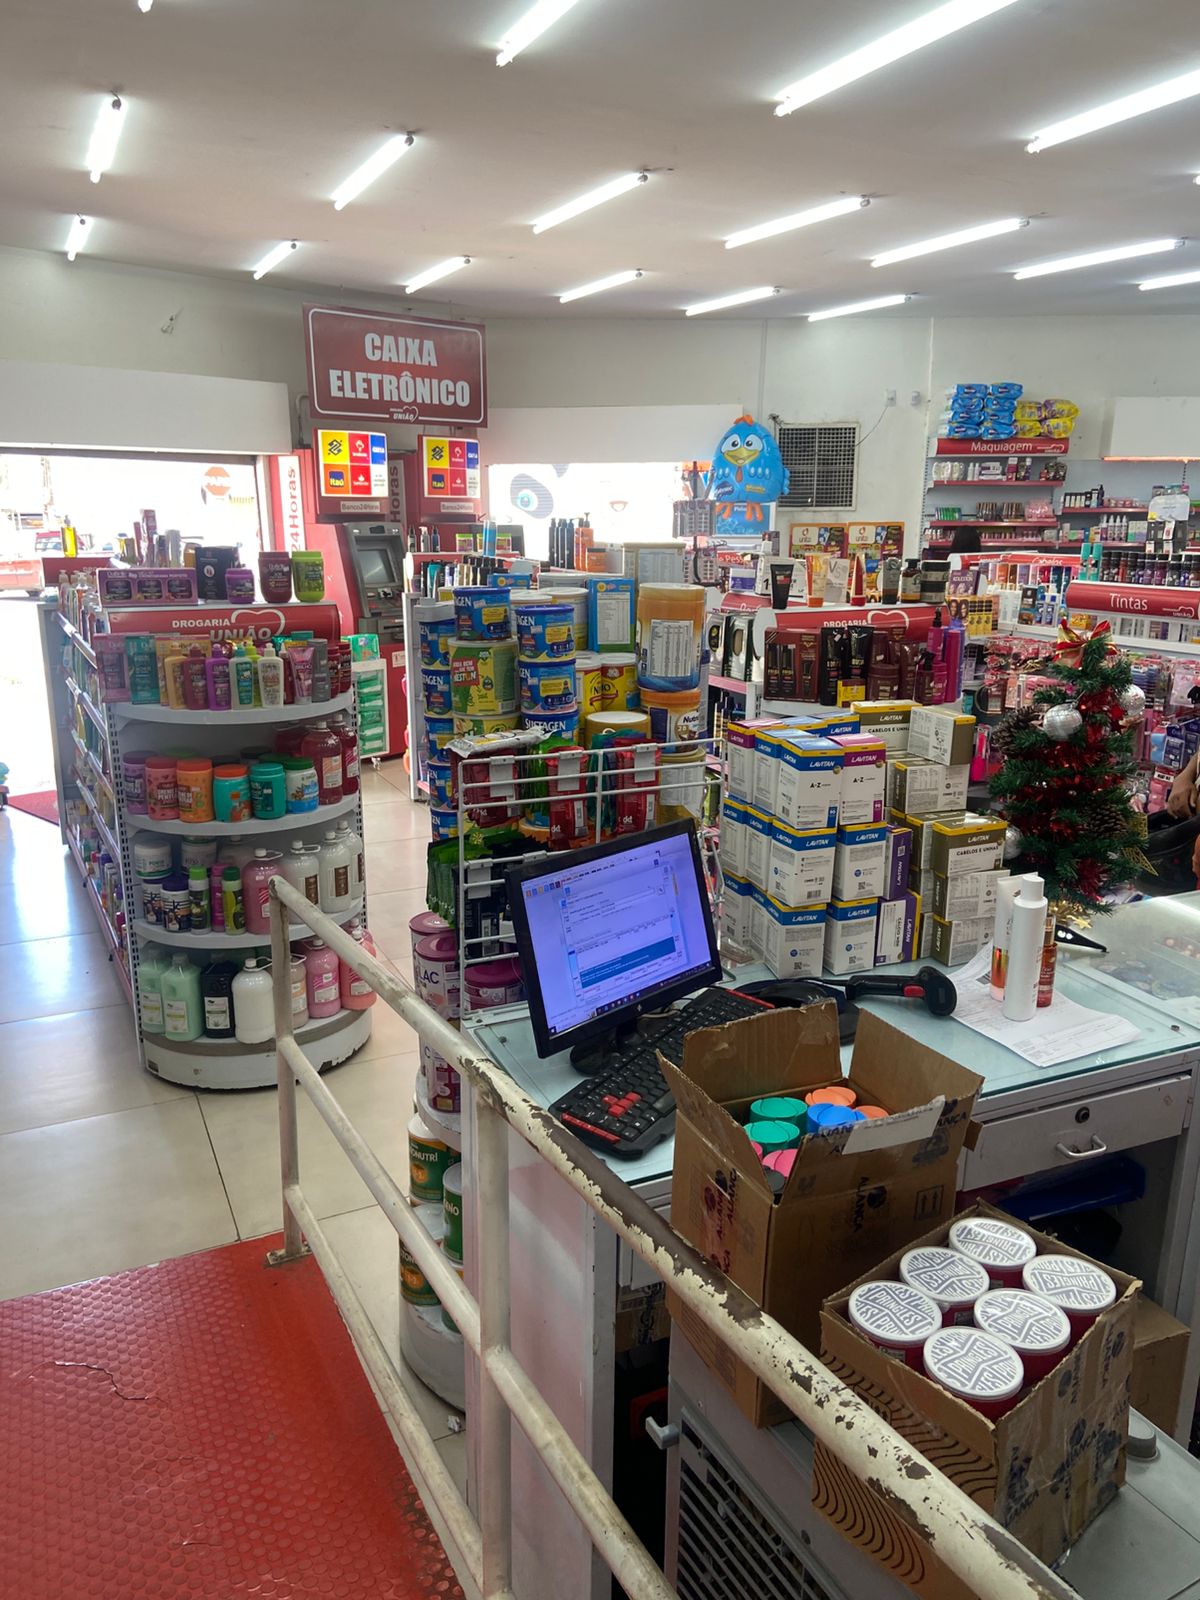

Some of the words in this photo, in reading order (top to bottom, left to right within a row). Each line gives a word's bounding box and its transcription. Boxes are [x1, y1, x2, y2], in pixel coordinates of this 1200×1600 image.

[364, 333, 438, 367] CAIXA
[329, 369, 471, 407] ELETRÔNICO
[971, 442, 1032, 453] Maquiagem
[1109, 593, 1149, 611] Tintas
[172, 618, 231, 628] DROGARIA
[210, 625, 272, 644] UNIÃO
[830, 726, 853, 734] LAVITAN
[809, 760, 835, 768] LAVITAN
[851, 754, 878, 763] LAVITAN
[776, 832, 793, 845] LAVITAN
[805, 839, 830, 847] LAVITAN
[855, 832, 880, 842] LAVITAN
[967, 834, 990, 843] LAVITAN
[847, 909, 871, 917] LAVITAN
[966, 1227, 1018, 1258] PRINGLES
[919, 1262, 971, 1288] PRINGLES
[1042, 1273, 1100, 1291] PRINGLES
[868, 1290, 923, 1327] PRINGLES
[996, 1301, 1045, 1333] PRINGLES
[947, 1340, 999, 1379] PRINGLES
